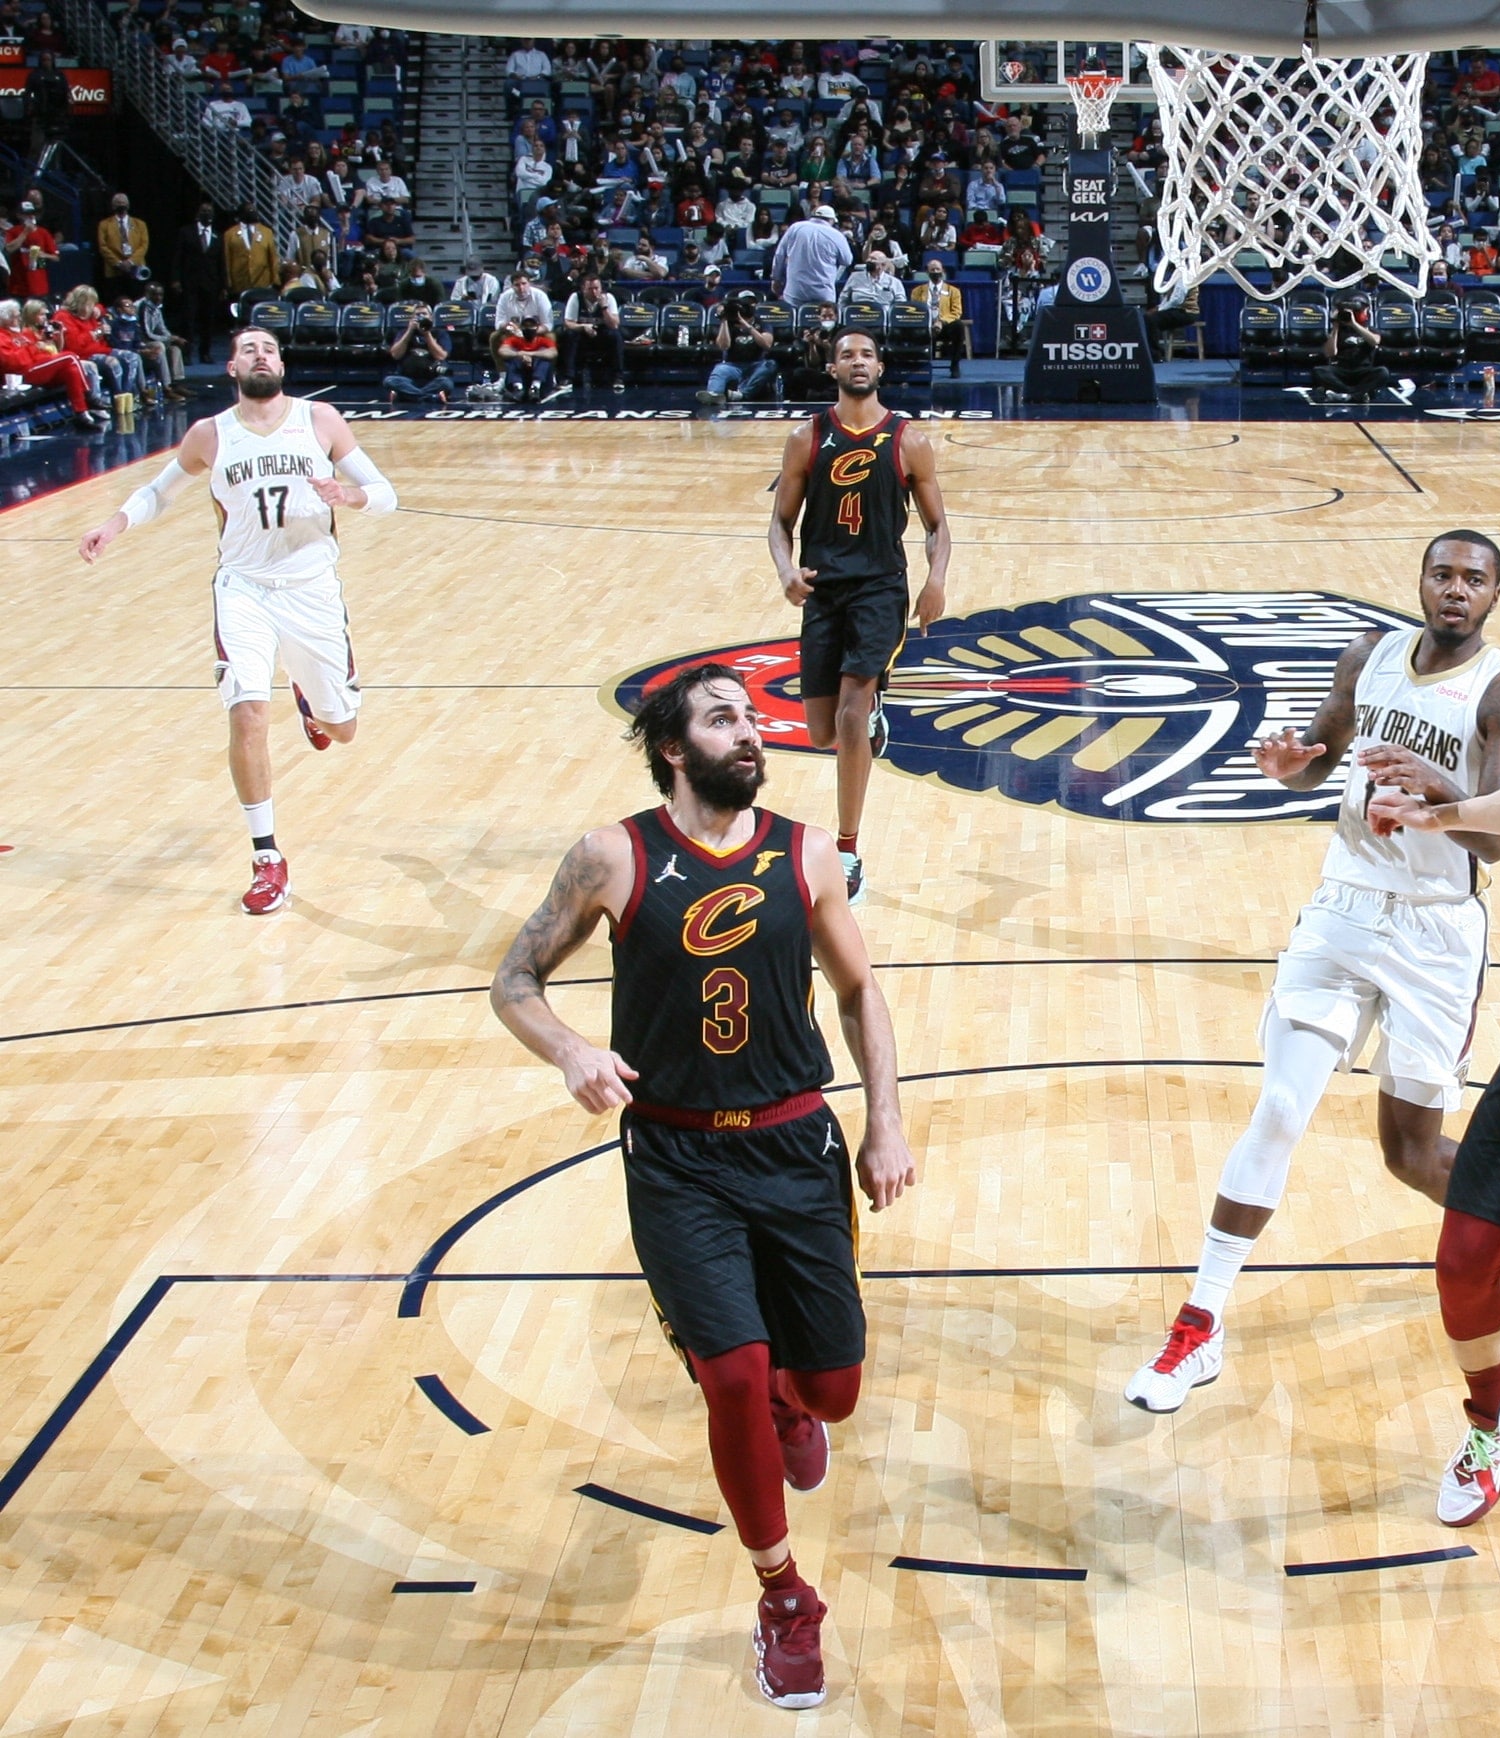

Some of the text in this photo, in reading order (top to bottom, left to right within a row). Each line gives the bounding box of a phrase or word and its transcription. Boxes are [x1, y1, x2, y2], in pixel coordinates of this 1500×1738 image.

[1073, 179, 1106, 191] SEAT
[1071, 192, 1107, 205] GEEK
[1042, 343, 1139, 360] TISSOT
[424, 410, 993, 419] ORLEANS PELANS
[225, 454, 314, 487] NEW ORLEANS
[253, 486, 289, 530] 17
[837, 492, 862, 536] 4
[1436, 684, 1469, 702] ibotta
[1355, 704, 1463, 772] EW ORLEANS
[702, 967, 749, 1055] 3
[713, 1109, 751, 1128] CAVS
